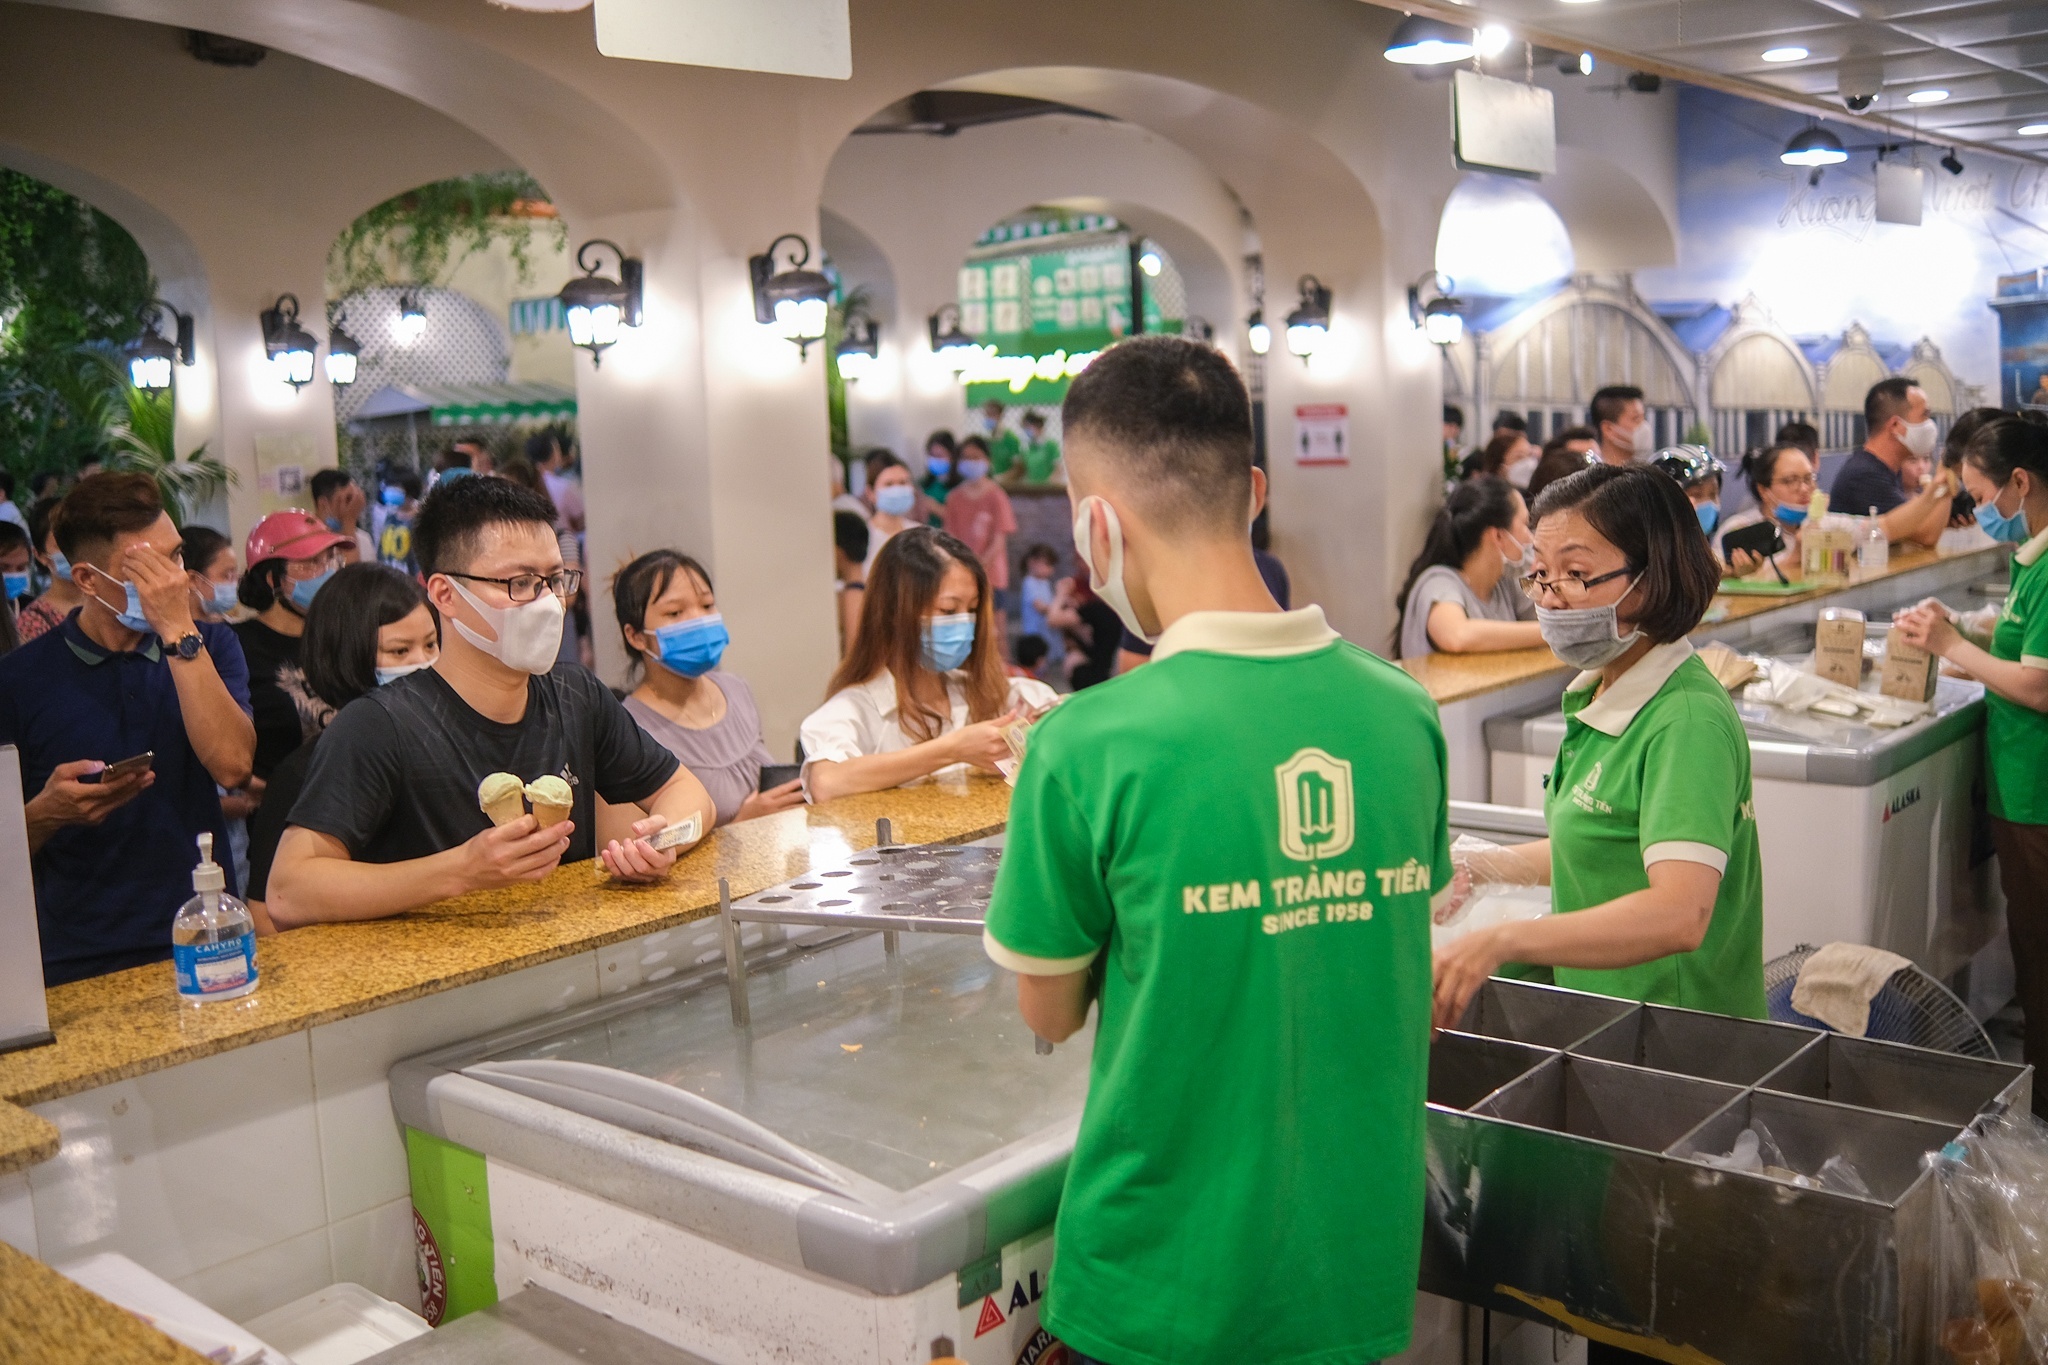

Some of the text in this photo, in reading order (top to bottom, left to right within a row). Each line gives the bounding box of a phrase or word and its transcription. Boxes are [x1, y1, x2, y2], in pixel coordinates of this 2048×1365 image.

[1891, 786, 1921, 814] ALASKA
[1183, 857, 1431, 914] KEM TRÀNG TIỀN
[1262, 901, 1374, 935] SINCE 1958
[1008, 1269, 1044, 1316] AL
